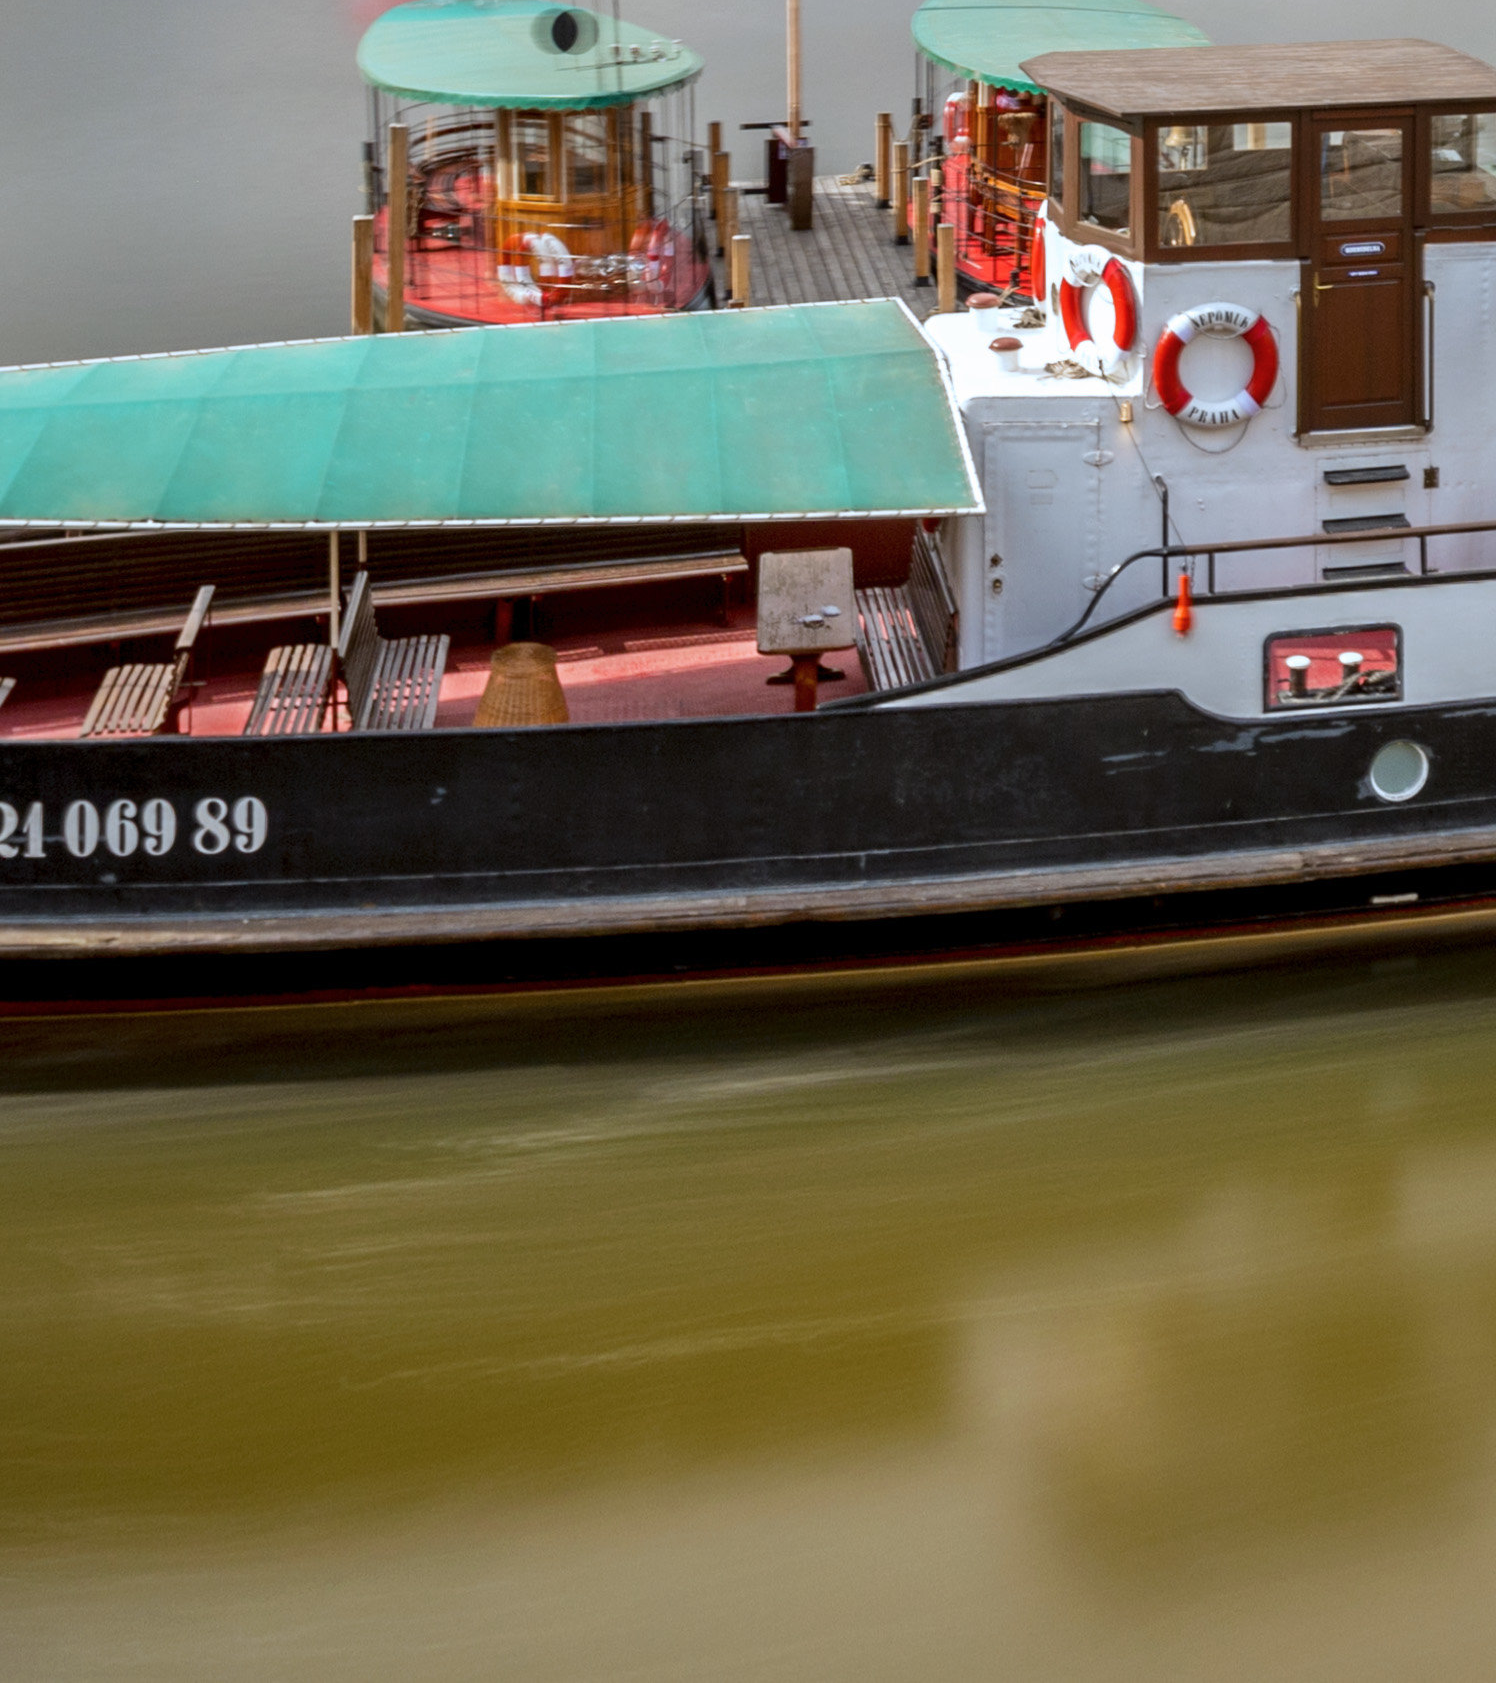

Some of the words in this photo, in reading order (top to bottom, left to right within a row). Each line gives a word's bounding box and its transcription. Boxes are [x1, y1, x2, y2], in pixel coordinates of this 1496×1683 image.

[1188, 406, 1240, 425] PRAHA
[64, 798, 177, 857] 069
[192, 796, 268, 855] 89
